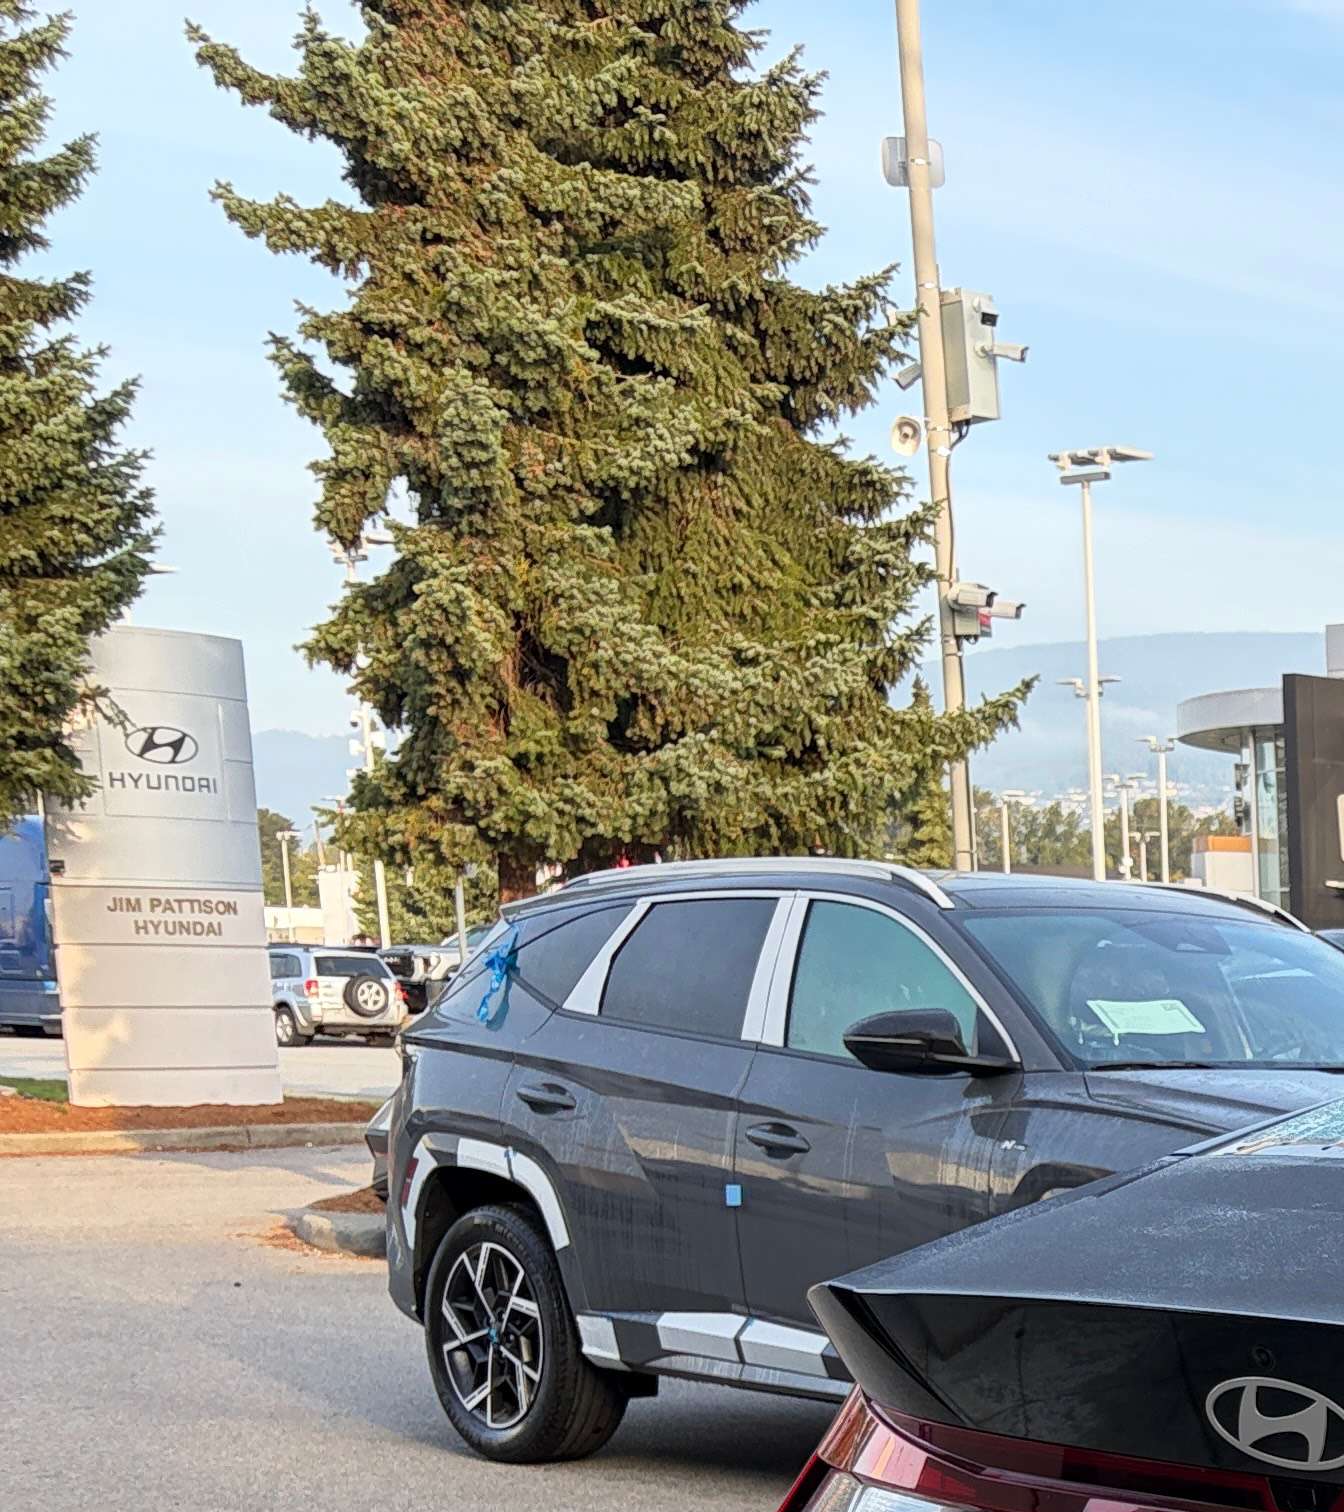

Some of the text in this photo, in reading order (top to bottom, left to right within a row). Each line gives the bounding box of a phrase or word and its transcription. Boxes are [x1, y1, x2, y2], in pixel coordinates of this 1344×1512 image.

[108, 772, 218, 794] HYUNDAI
[107, 897, 238, 915] JIM PATTISON
[134, 920, 223, 936] HYUNDAI
